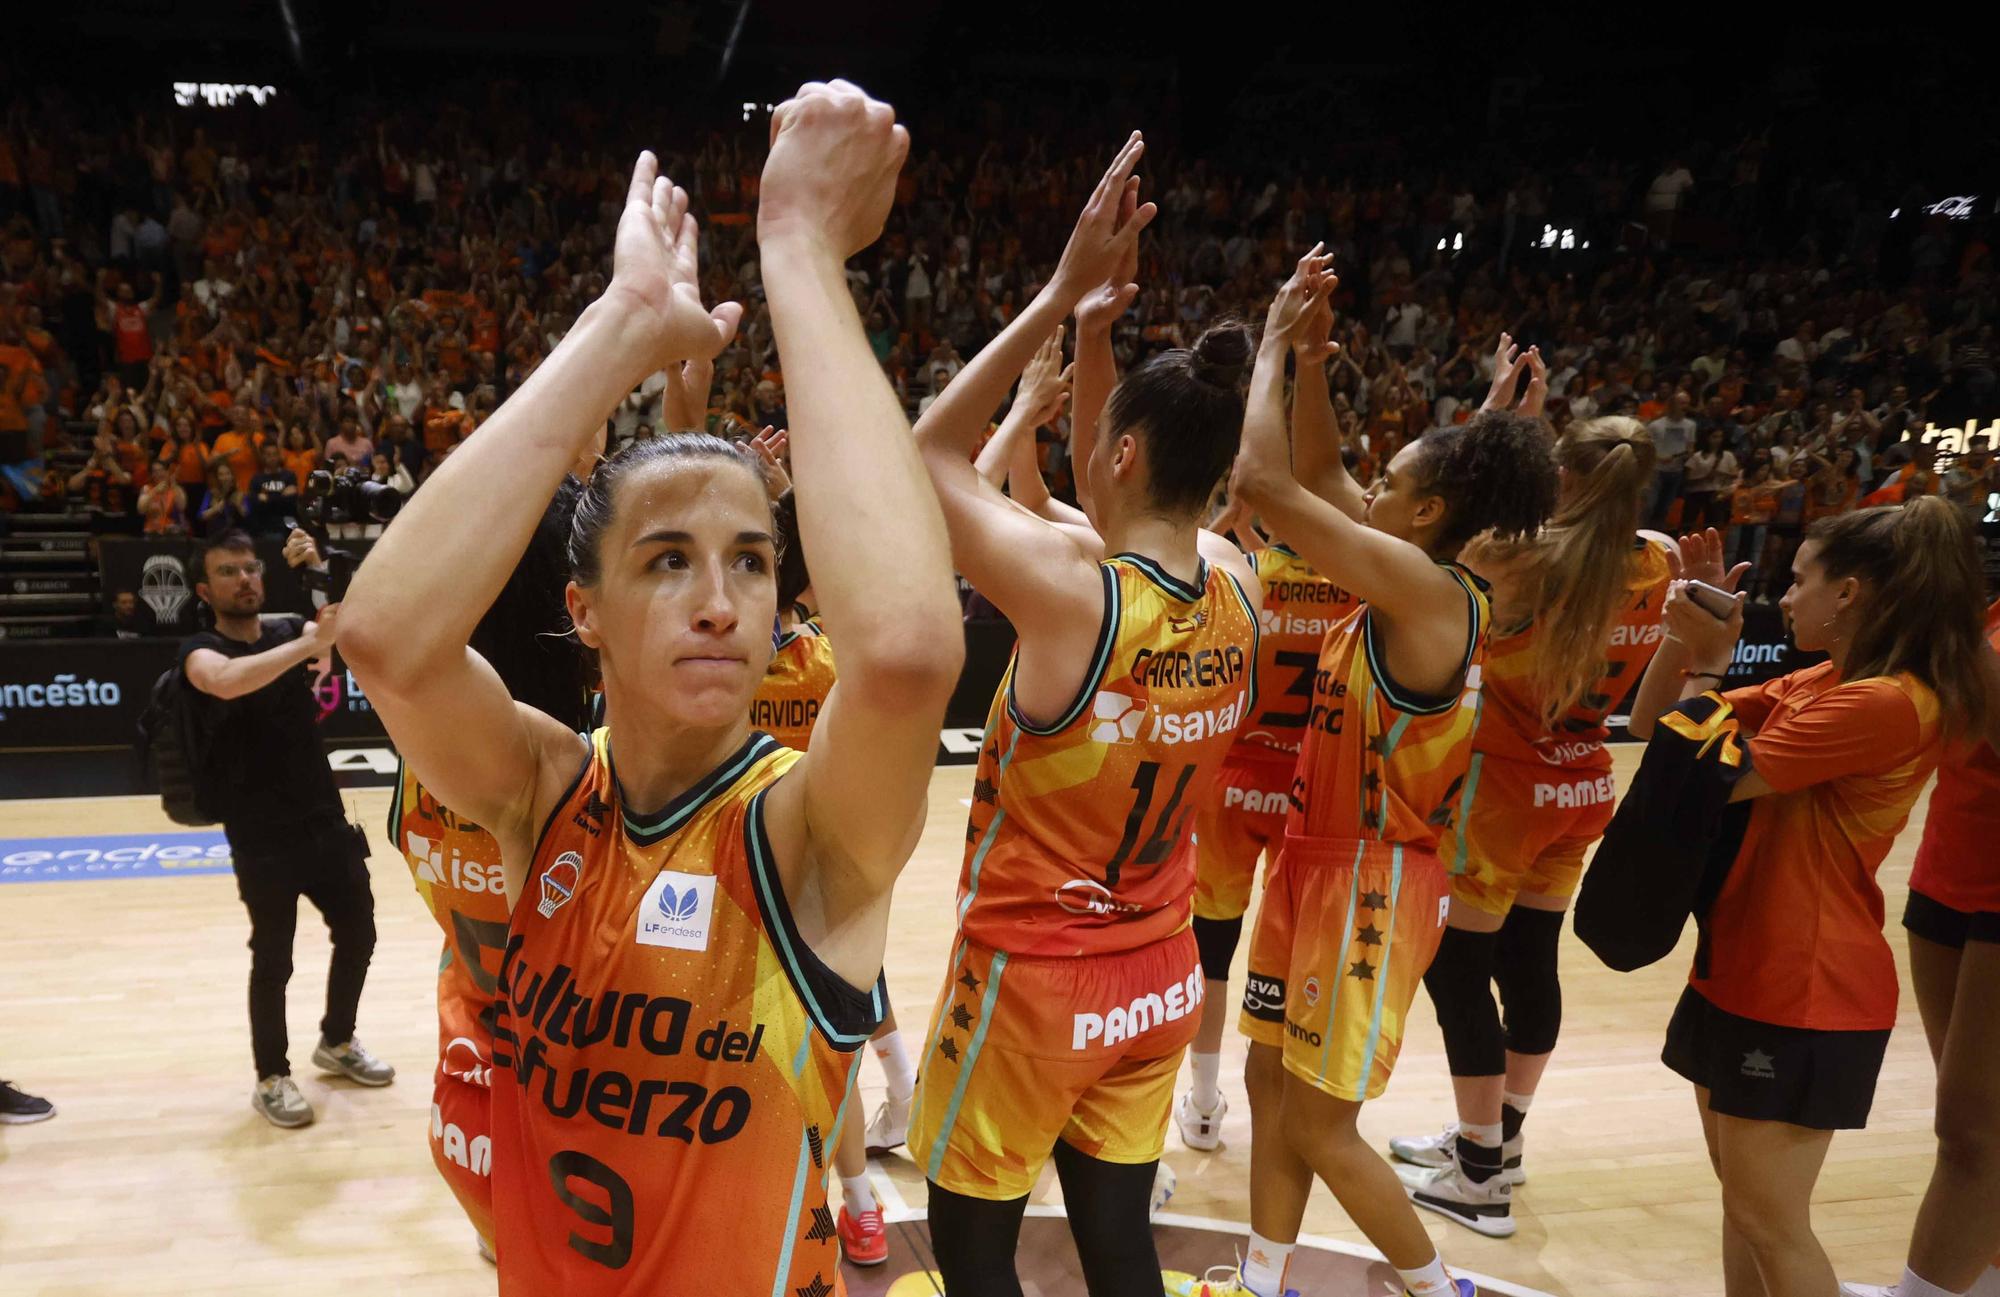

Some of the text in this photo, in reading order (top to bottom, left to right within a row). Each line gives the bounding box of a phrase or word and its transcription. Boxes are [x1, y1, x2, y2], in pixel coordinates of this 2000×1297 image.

[1610, 622, 1662, 646] ava
[1731, 638, 1788, 664] lonc
[1131, 646, 1244, 689] CARRERA
[0, 674, 121, 708] ncesto
[1148, 690, 1245, 745] isaval
[1224, 786, 1290, 815] PAM
[452, 848, 505, 895] isa
[1247, 977, 1281, 998] EVA
[695, 1020, 765, 1063] del
[549, 1149, 635, 1270] 9
